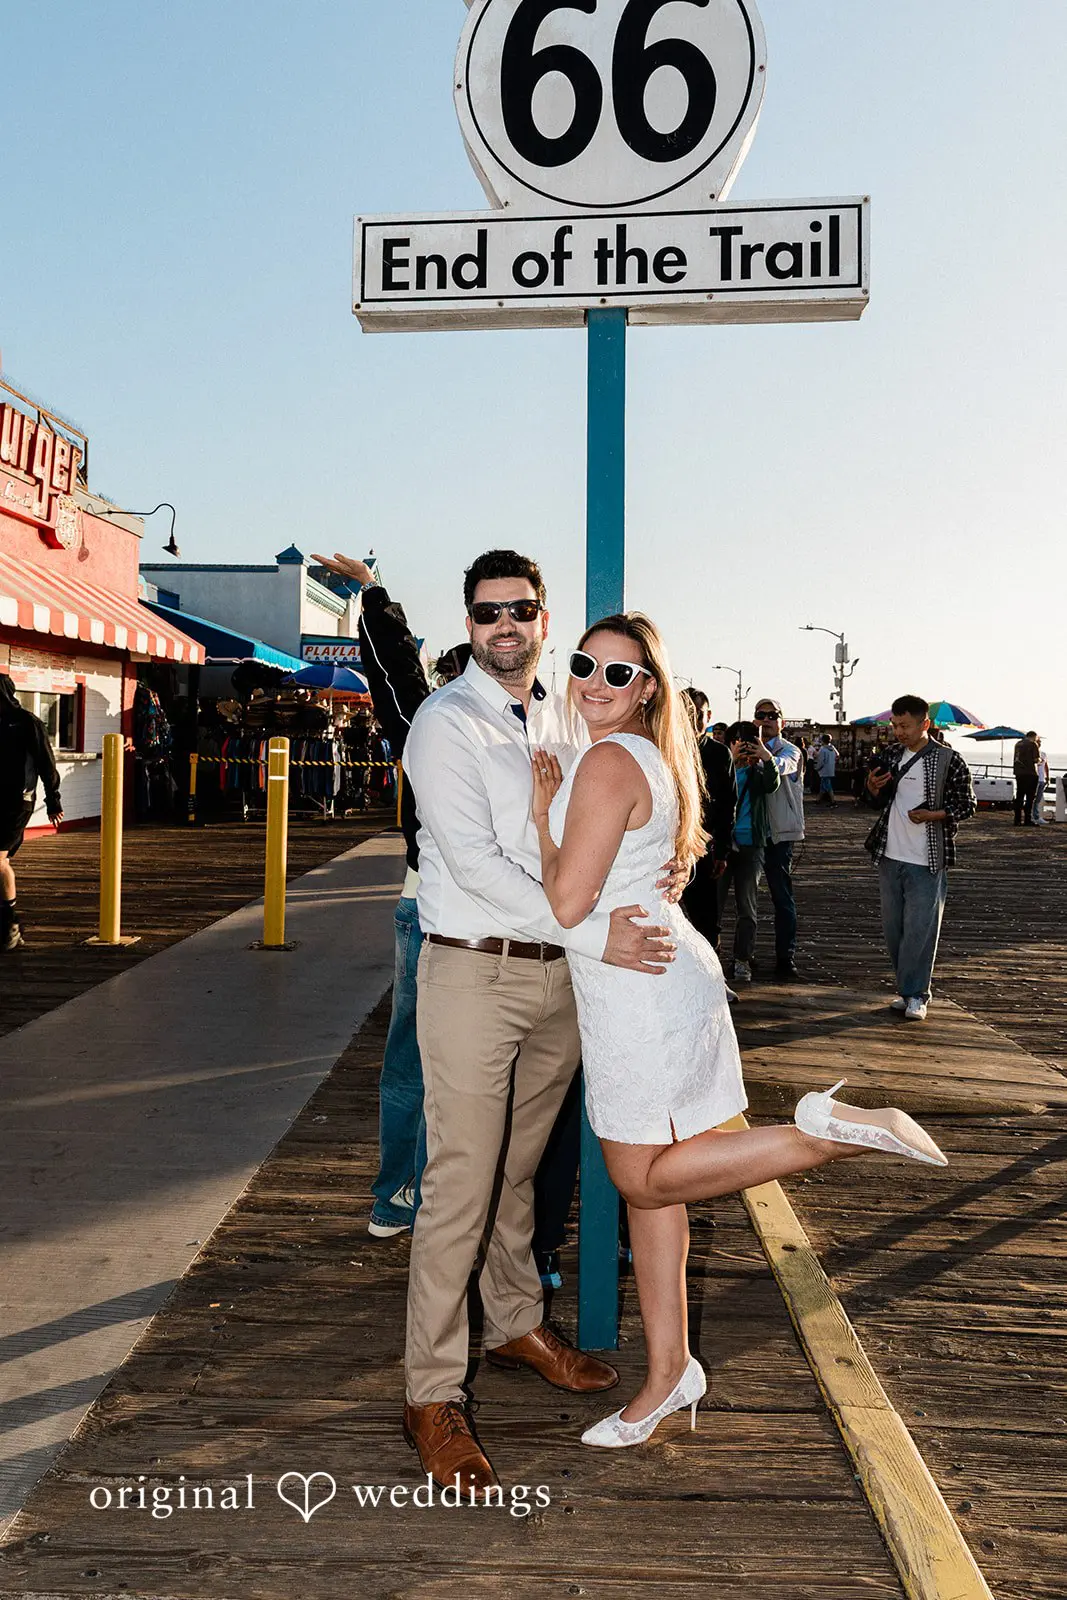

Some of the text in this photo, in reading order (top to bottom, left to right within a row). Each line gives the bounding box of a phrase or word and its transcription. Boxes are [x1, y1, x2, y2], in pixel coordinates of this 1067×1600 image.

[500, 0, 717, 168] 66
[381, 214, 840, 291] End of the Trail
[305, 645, 360, 656] PLAYLA
